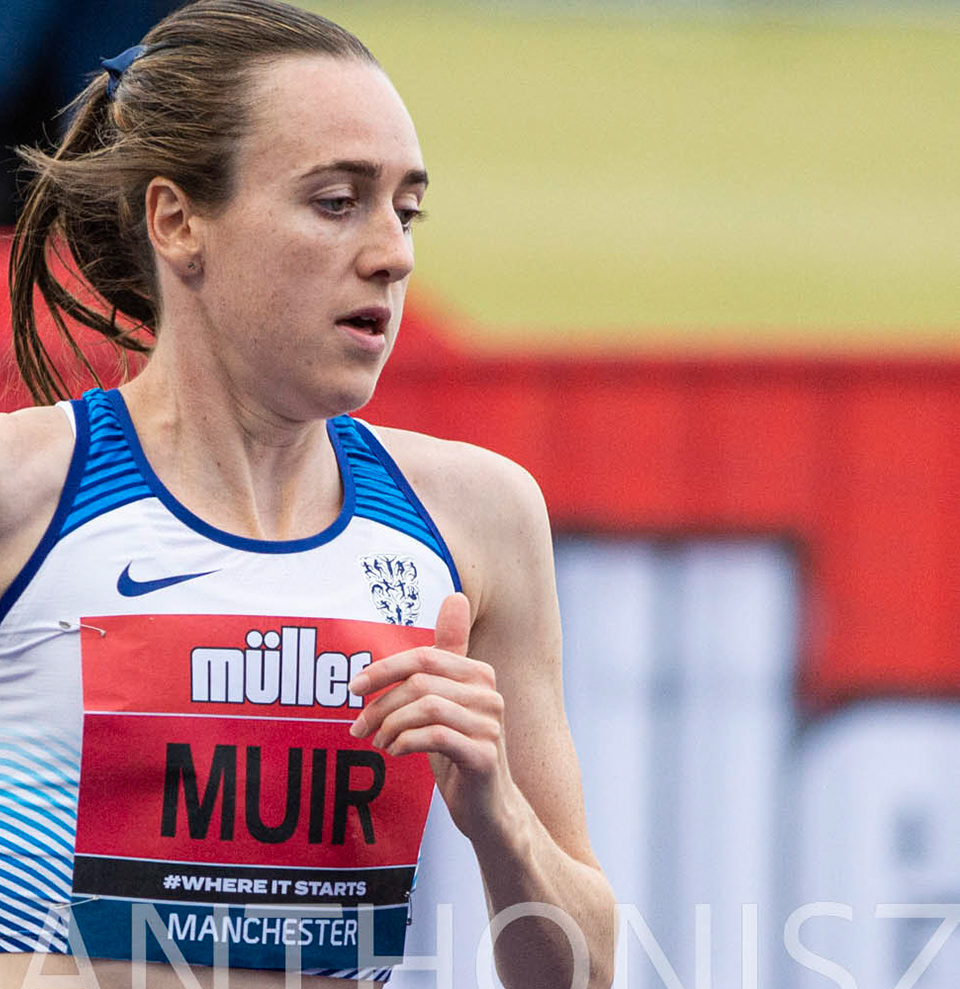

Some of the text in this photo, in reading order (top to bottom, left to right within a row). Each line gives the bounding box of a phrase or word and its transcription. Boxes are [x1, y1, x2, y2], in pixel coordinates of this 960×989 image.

[190, 626, 372, 709] müller
[160, 742, 386, 845] MUIR
[163, 874, 367, 897] #WHERE IT STARTS
[167, 912, 358, 947] MANCHESTER
